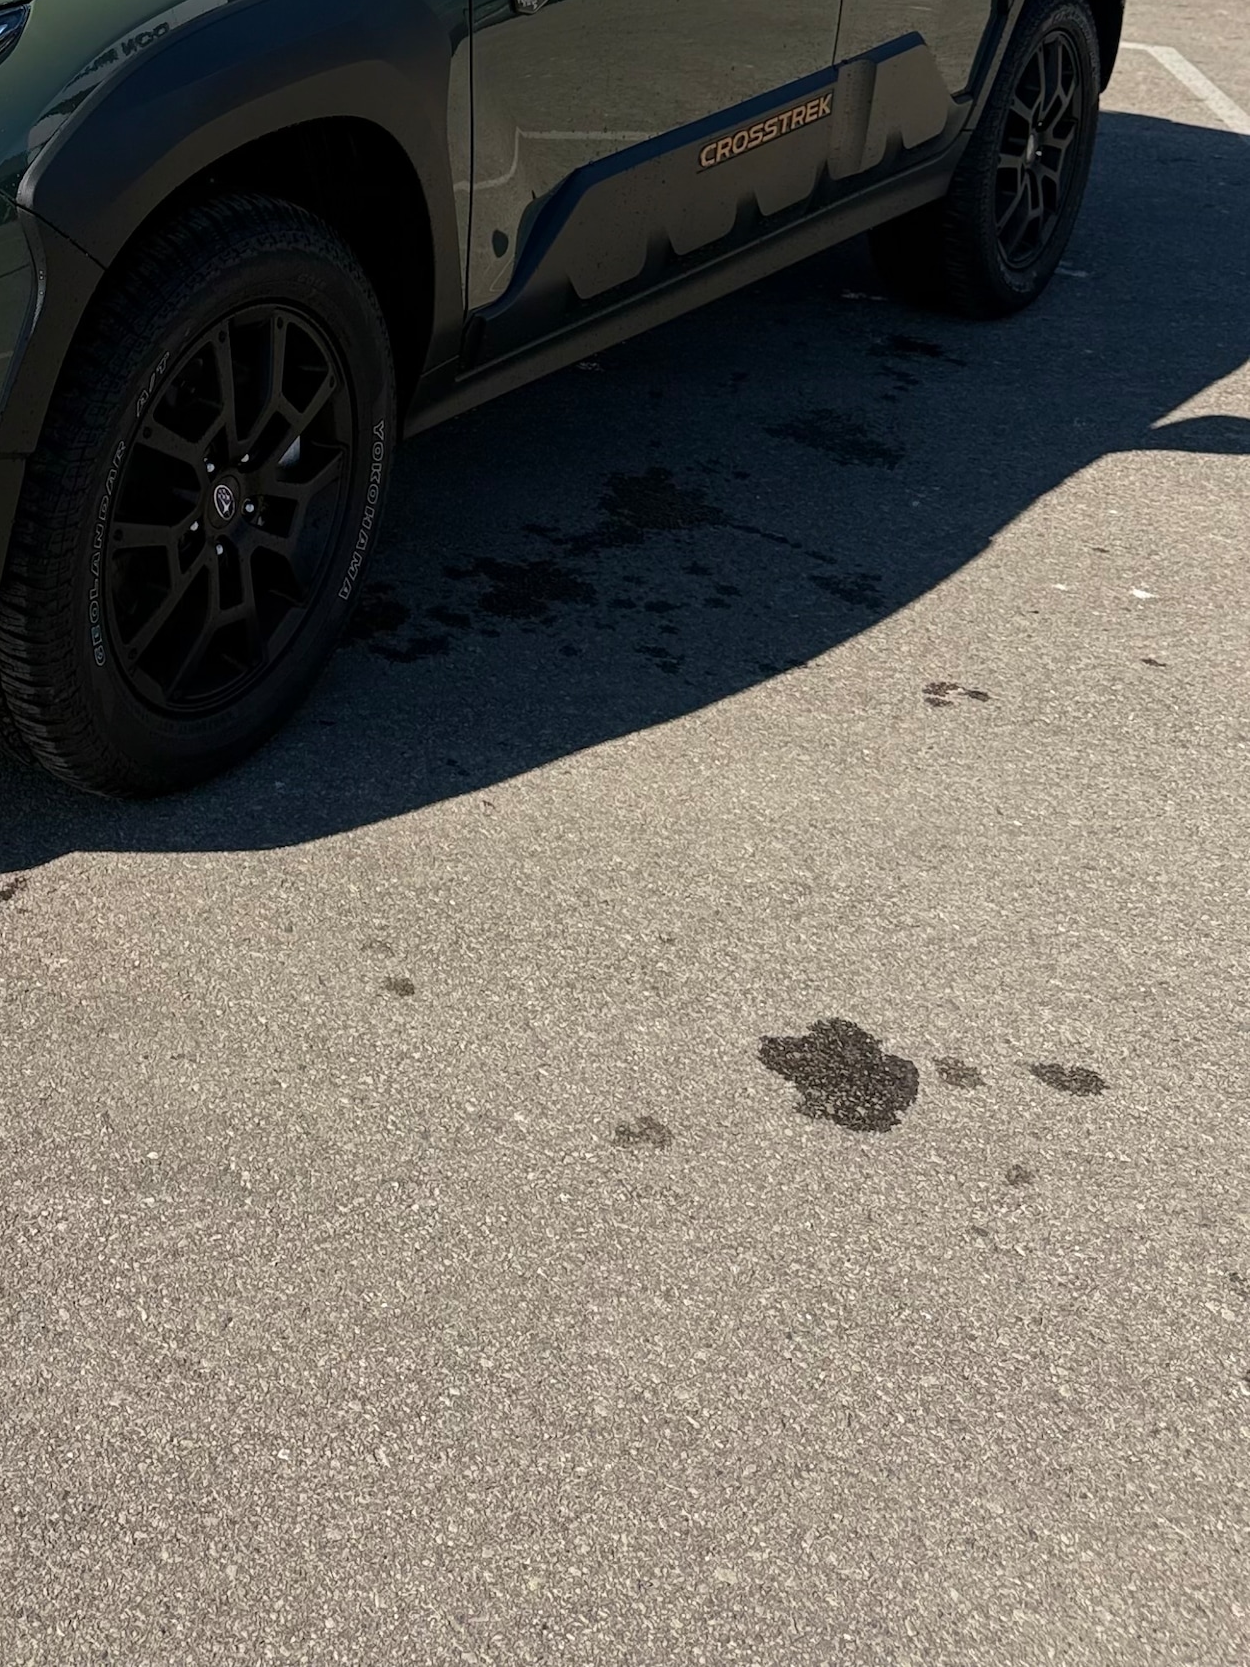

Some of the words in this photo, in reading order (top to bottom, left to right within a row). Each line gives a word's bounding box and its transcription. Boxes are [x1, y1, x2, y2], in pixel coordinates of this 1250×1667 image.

[699, 92, 833, 168] CROSSTREK
[89, 439, 126, 667] GEOLANDAR
[135, 349, 171, 419] A/T
[337, 418, 385, 601] YOKOHAMA
